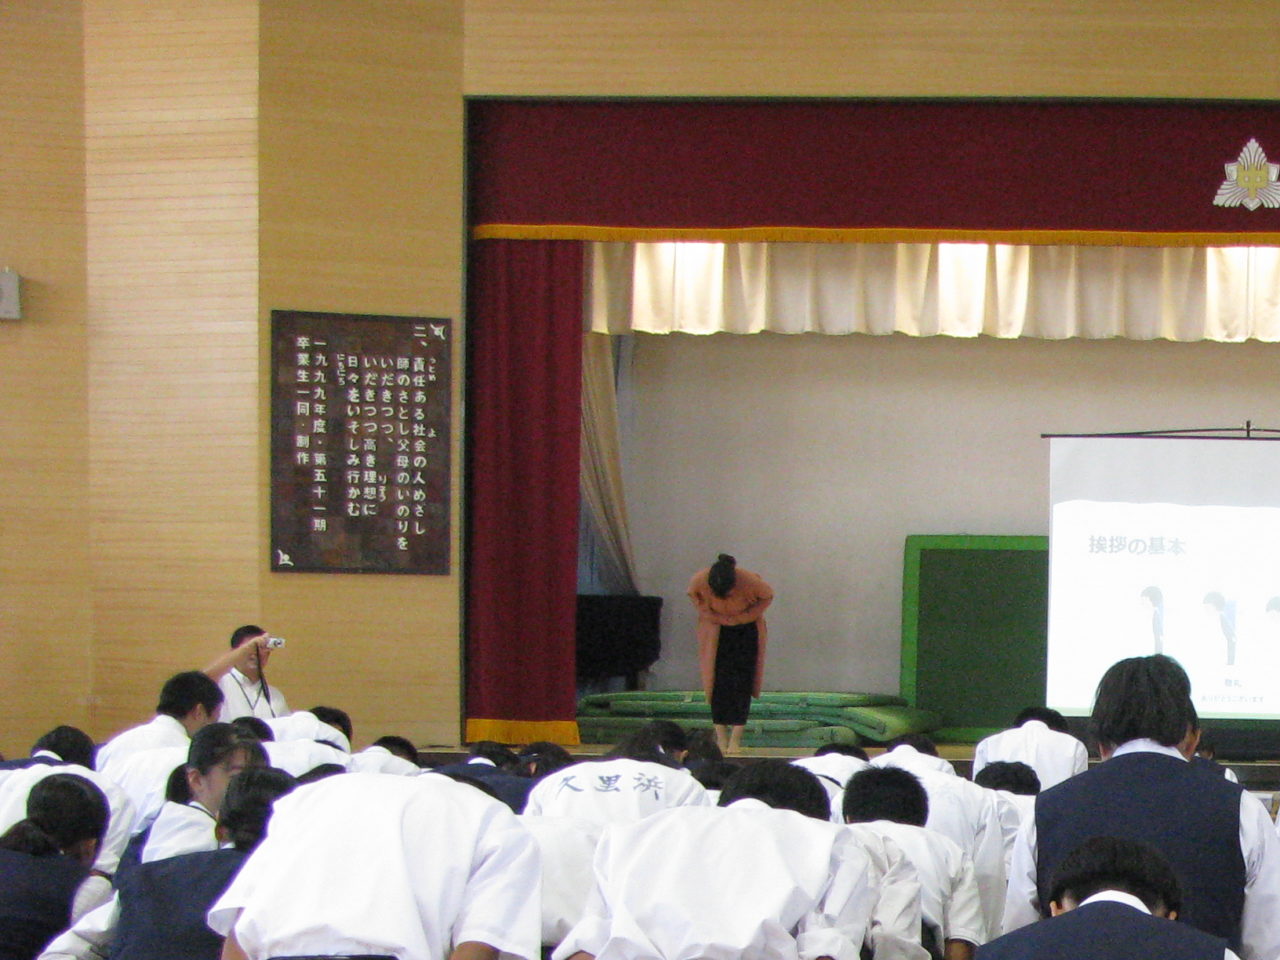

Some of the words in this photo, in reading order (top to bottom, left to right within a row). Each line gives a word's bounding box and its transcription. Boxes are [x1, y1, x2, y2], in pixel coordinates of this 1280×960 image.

[1088, 534, 1187, 556] 挨拶の基本
[555, 772, 664, 801] 久里浜
